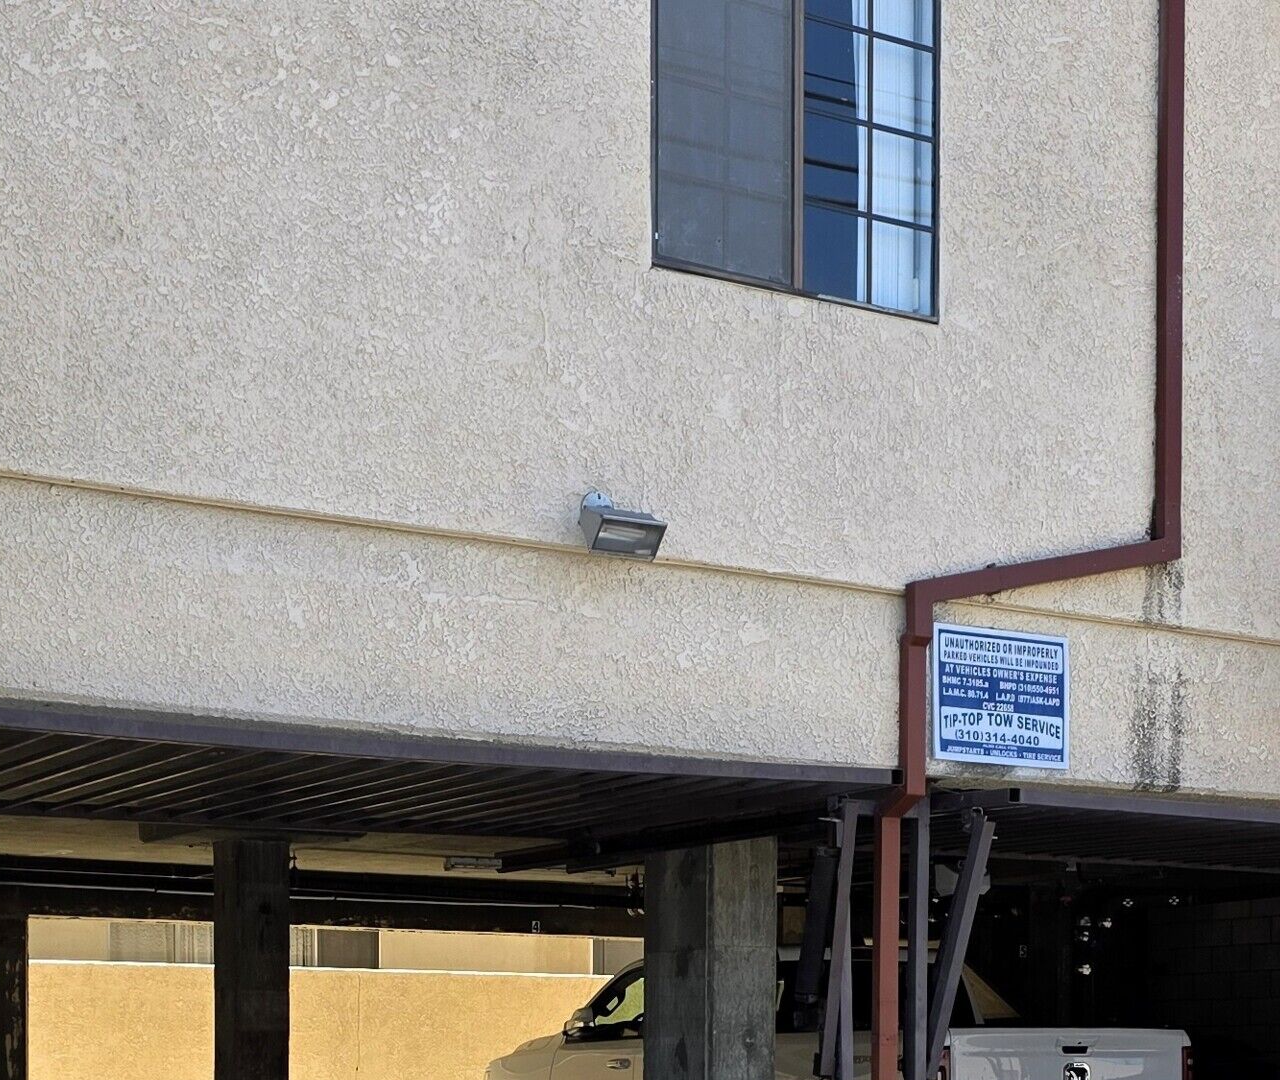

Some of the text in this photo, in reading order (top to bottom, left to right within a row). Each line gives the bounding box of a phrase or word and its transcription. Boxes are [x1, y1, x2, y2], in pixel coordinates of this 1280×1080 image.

[944, 636, 1058, 659] UNAUTHORIZED OR IMPROPERLY
[944, 651, 1059, 670] PARKED VEHICLES WILL BE IMPOUNDED
[945, 664, 1057, 684] AT VEHICLES OWNER'S EXPENSE
[944, 712, 1061, 739] TIP-TOP TOW SERVICE
[955, 729, 1040, 746] (310)314-4040
